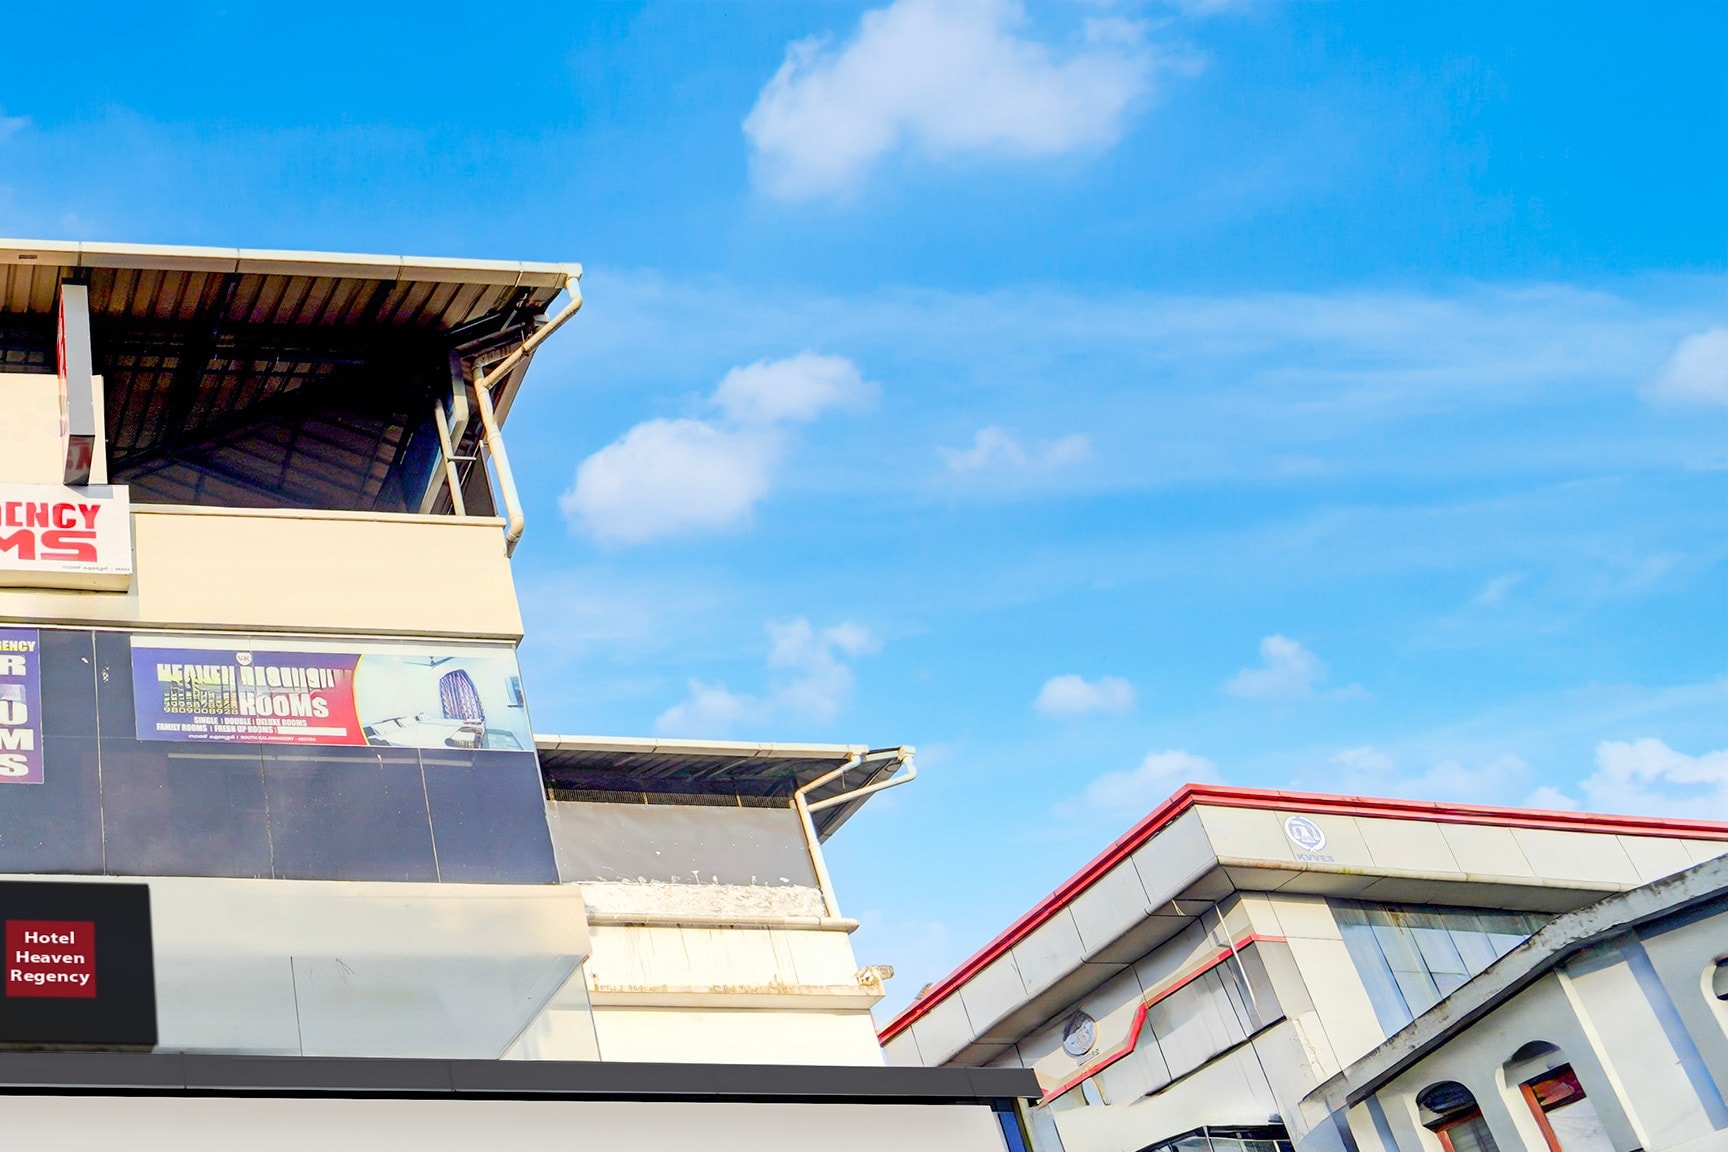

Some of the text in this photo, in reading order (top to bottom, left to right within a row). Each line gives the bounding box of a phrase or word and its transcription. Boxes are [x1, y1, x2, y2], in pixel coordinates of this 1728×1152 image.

[194, 717, 308, 727] SINGLE DOUBLE DELUXE ROOMS
[156, 723, 181, 731] FAMILY
[182, 724, 207, 732] ROOMS
[237, 725, 247, 733] UP
[248, 725, 273, 733] ROOMS
[1296, 853, 1335, 863] KVVES
[24, 931, 75, 944] Hotel
[15, 950, 85, 964] Heaven
[10, 969, 90, 986] Regency
